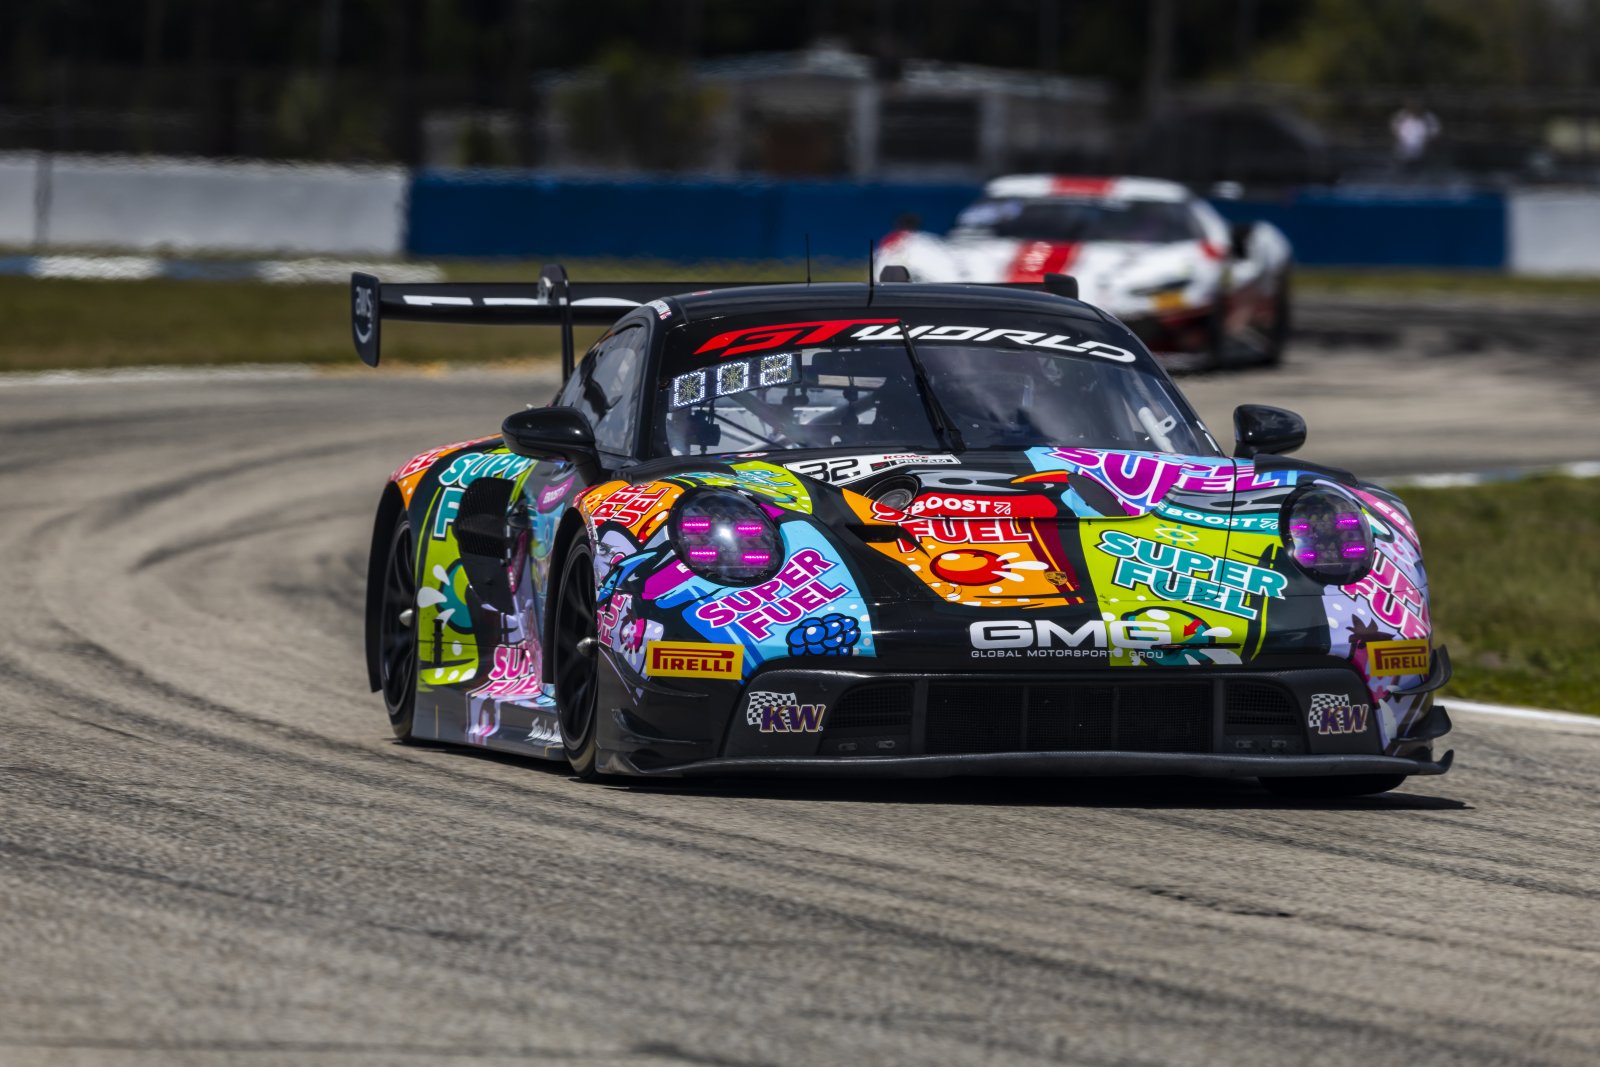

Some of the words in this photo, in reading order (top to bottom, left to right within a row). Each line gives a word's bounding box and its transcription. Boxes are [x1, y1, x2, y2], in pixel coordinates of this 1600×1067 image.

[693, 318, 901, 357] GT
[850, 325, 1136, 363] WORLD
[799, 458, 861, 483] 32
[898, 518, 1033, 553] FUEL
[1098, 530, 1288, 599] SUPER
[695, 549, 837, 628] SUPER
[1114, 558, 1260, 620] FUEL
[736, 582, 851, 641] FUEL
[969, 619, 1172, 649] GMG
[652, 647, 735, 673] PIRELLI
[971, 650, 1022, 658] GLOBAL
[1374, 645, 1427, 670] PIRELLI
[759, 703, 826, 732] KW
[1318, 704, 1369, 734] KW
